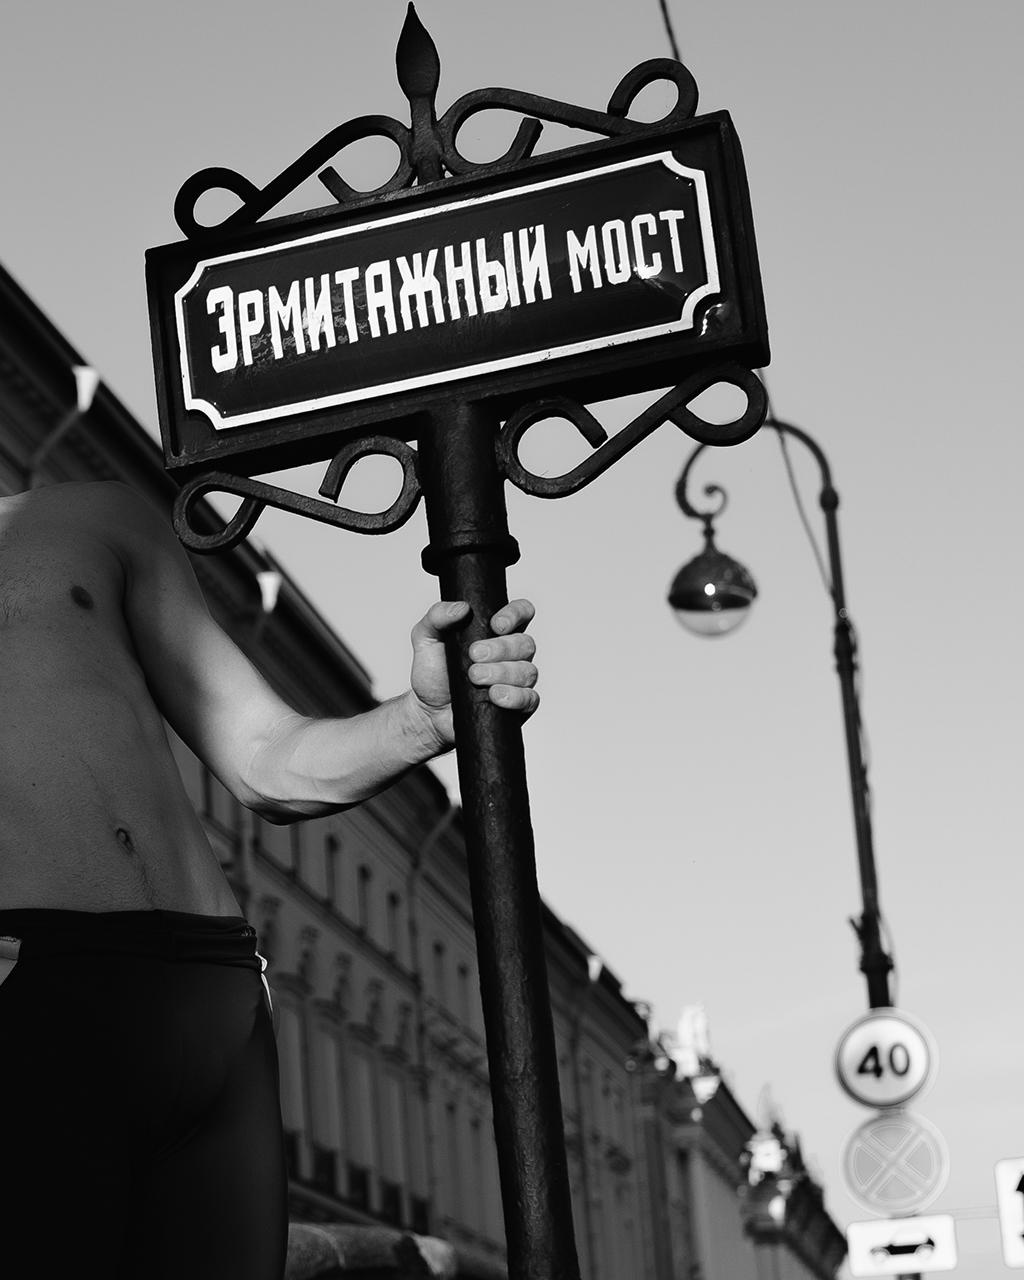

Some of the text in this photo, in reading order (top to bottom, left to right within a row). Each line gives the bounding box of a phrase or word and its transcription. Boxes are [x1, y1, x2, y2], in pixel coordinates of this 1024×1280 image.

[206, 209, 685, 374] ЭРМИТАЖНЫЙ МОСТ
[856, 1043, 911, 1078] 40
